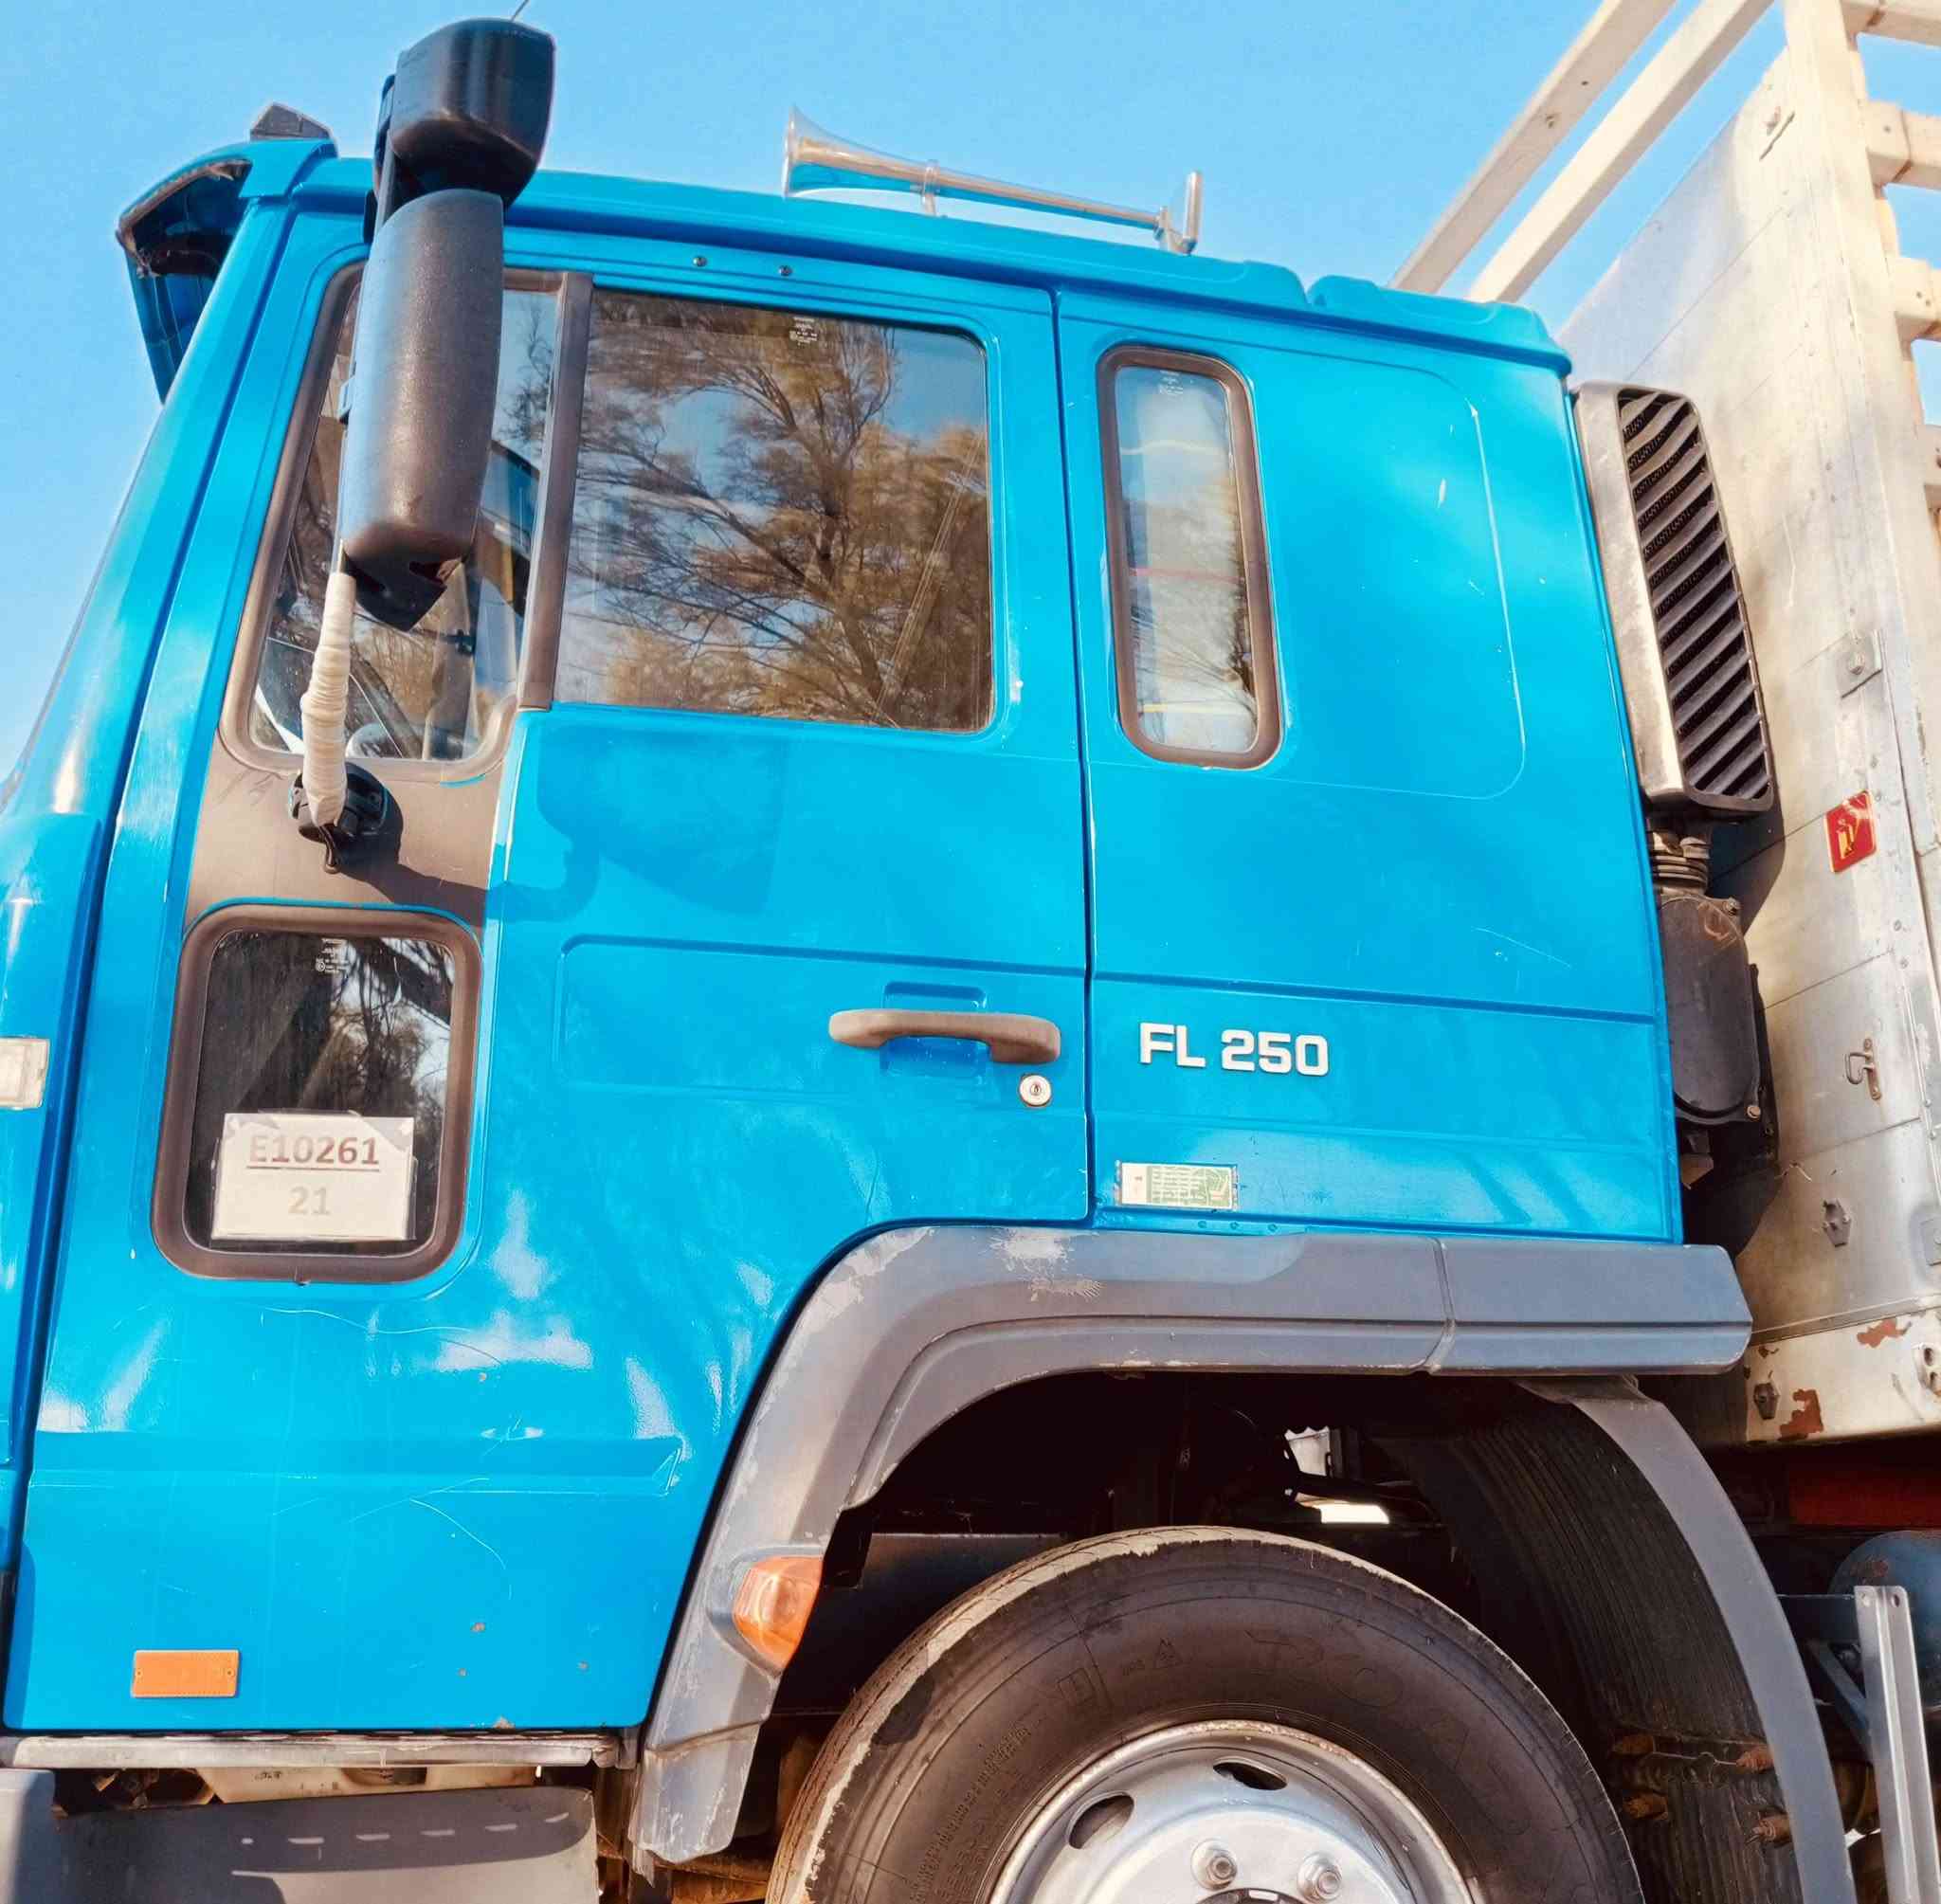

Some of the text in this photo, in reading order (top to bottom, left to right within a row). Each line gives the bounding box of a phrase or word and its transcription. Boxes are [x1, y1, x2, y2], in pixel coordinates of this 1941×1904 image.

[1139, 1022, 1329, 1077] FL 250
[249, 1134, 379, 1166] E10261
[288, 1186, 331, 1216] 21
